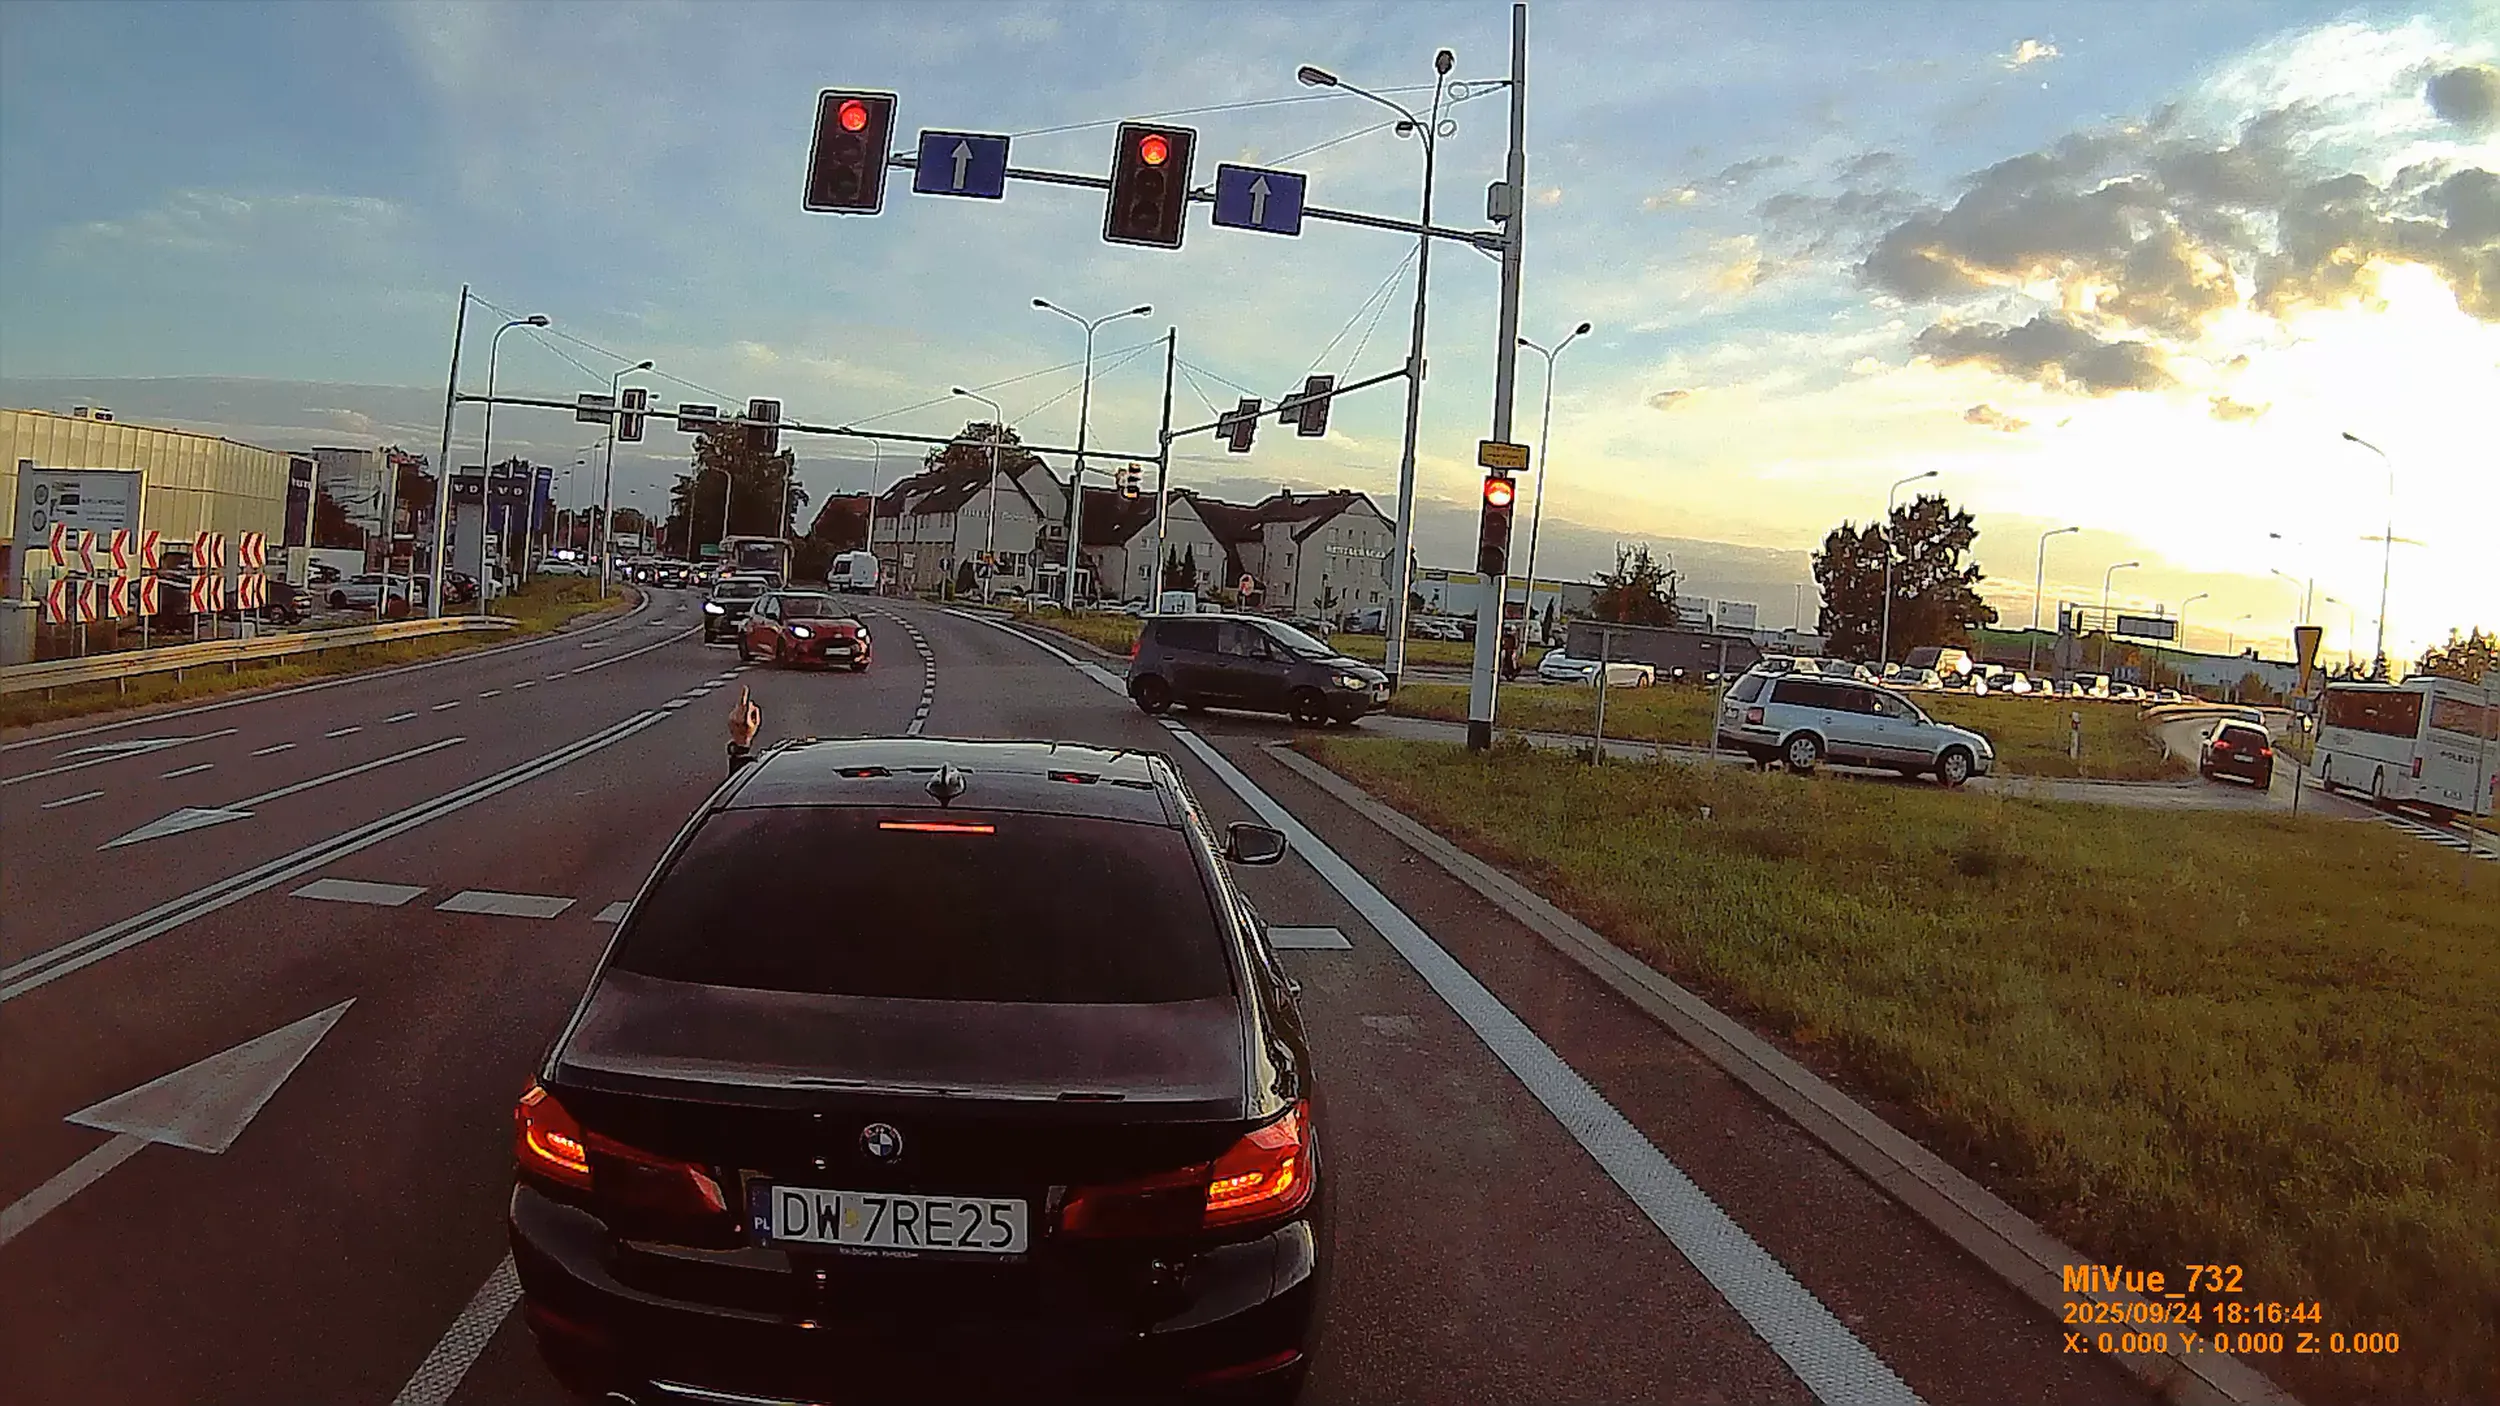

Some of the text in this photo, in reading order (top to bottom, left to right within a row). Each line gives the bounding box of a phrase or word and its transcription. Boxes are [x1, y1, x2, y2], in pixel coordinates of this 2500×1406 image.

[754, 1216, 770, 1231] PL
[782, 1192, 1013, 1248] DW 7RE25
